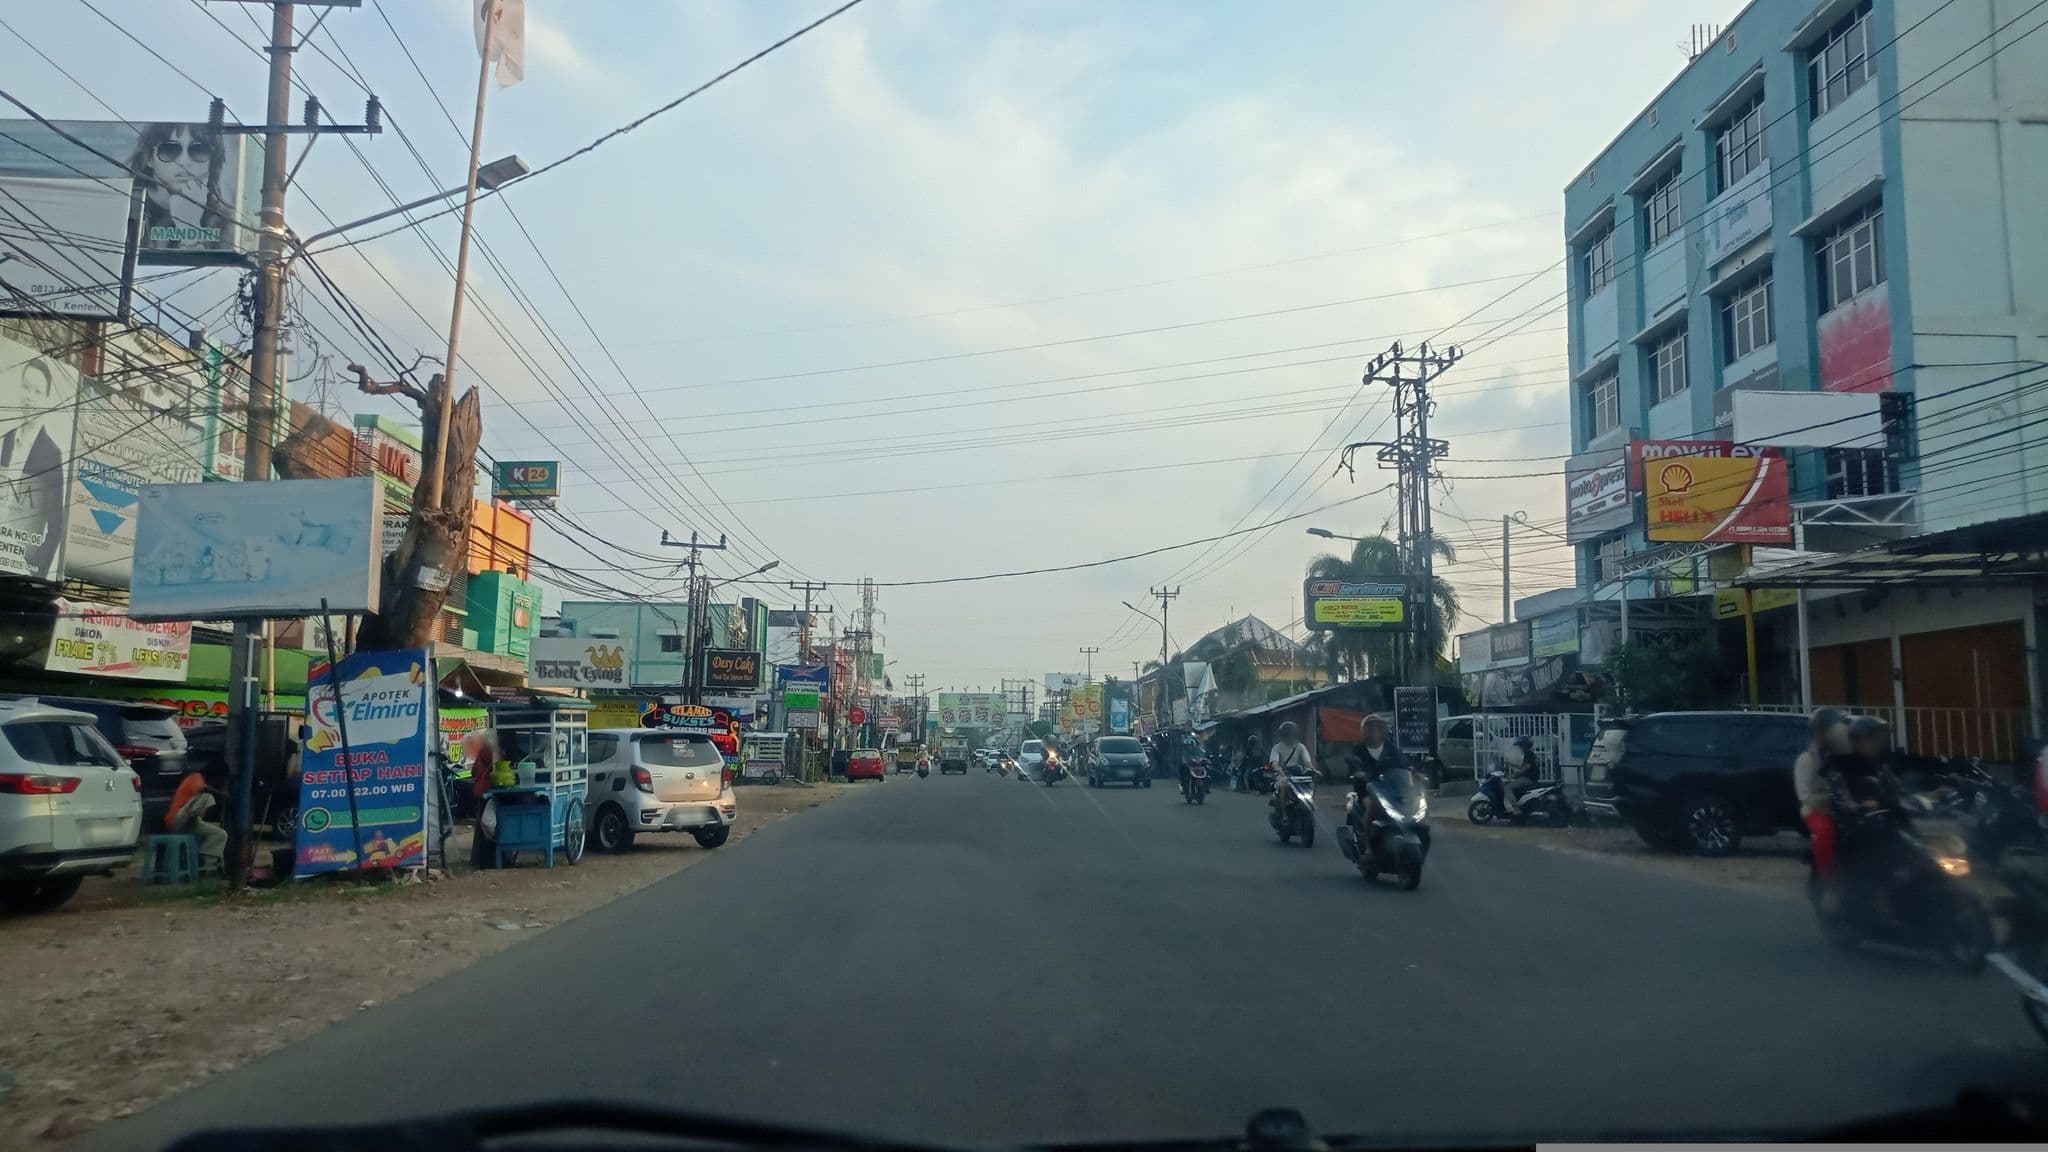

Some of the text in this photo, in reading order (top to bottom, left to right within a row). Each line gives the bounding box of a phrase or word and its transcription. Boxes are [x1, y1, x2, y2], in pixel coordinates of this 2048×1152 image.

[151, 226, 221, 242] MANDIRI
[1658, 497, 1685, 507] Shell
[383, 520, 409, 529] RAK
[535, 664, 582, 681] Bebek
[712, 656, 754, 673] Desy Cake
[362, 690, 410, 702] APOTEK
[352, 699, 419, 722] Elmira
[663, 713, 716, 727] SUKSES
[335, 751, 388, 767] BUKA
[303, 763, 423, 786] SETIAP HARI
[311, 782, 416, 799] 07.00 22.00 WIB
